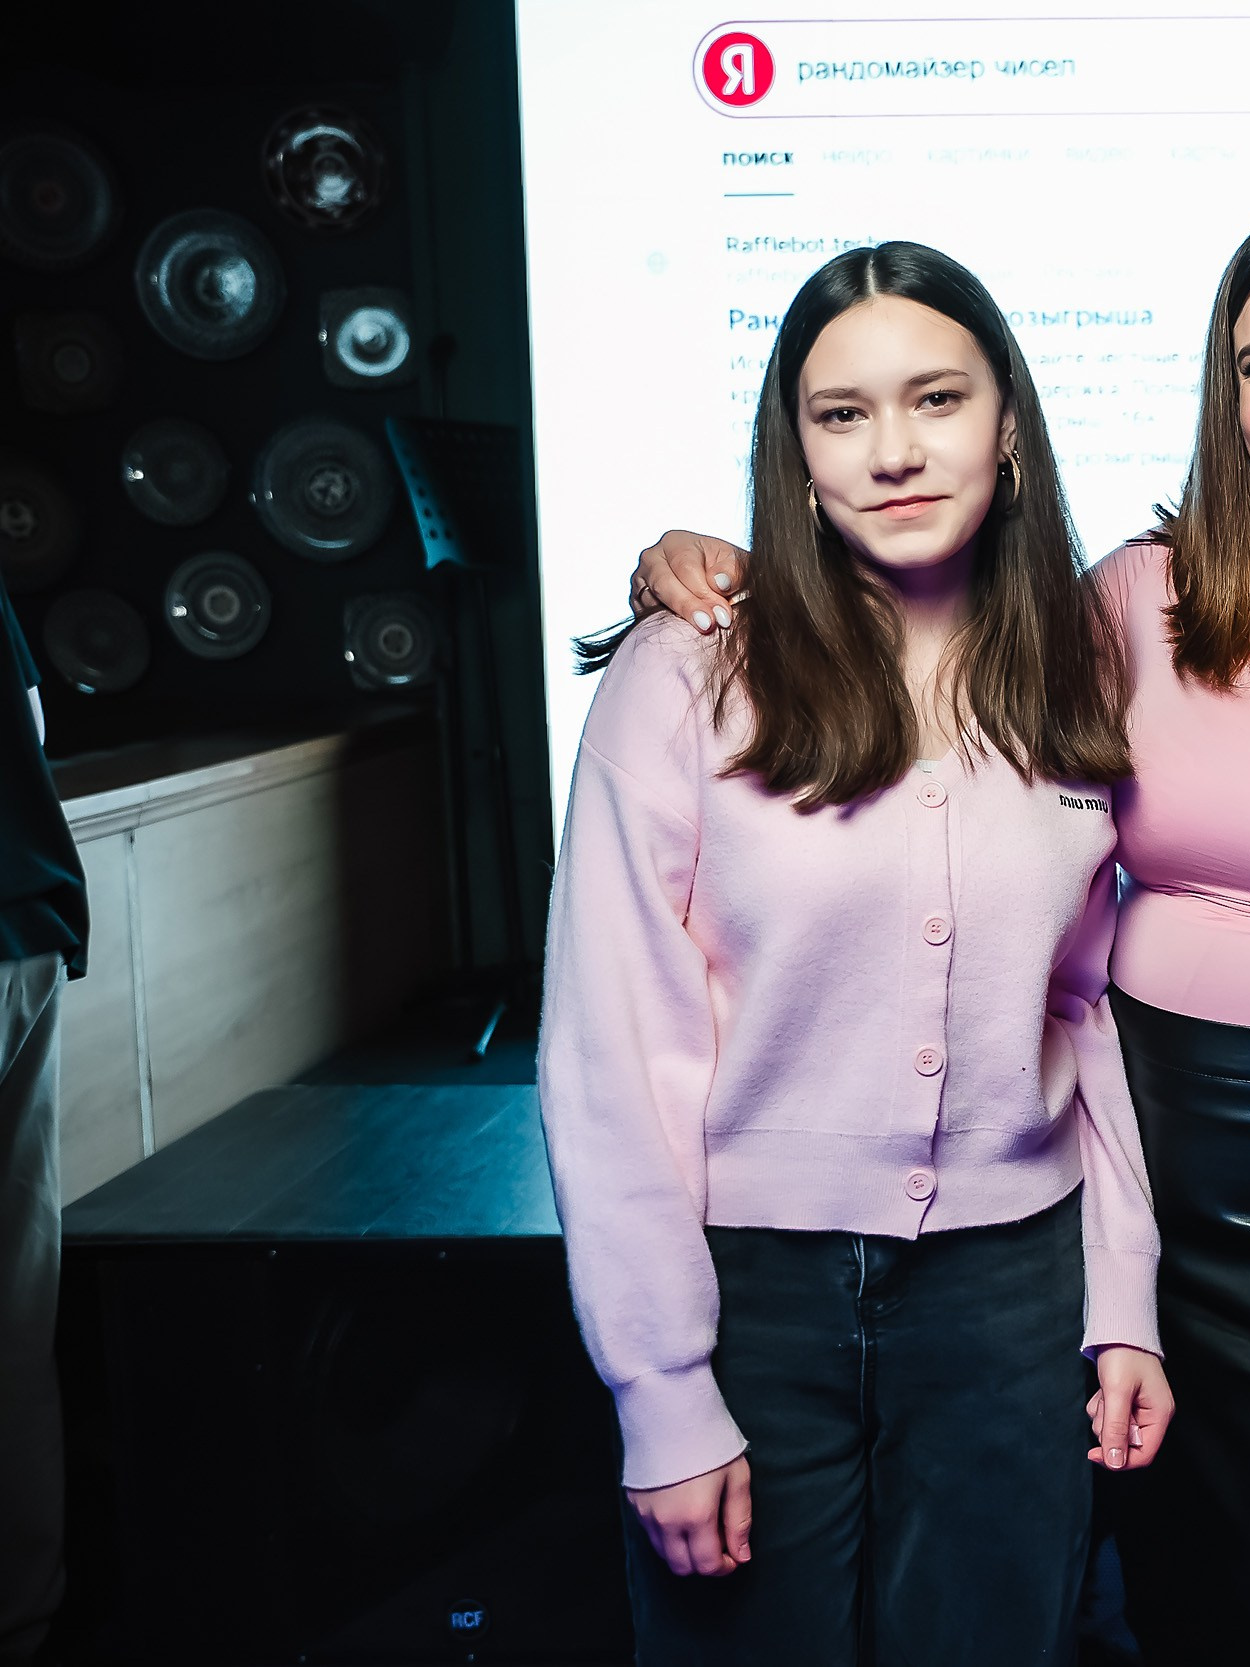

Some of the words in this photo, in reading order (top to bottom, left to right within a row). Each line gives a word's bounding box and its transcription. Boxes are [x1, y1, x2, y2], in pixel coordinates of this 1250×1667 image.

[720, 42, 756, 97] Я
[798, 57, 985, 83] рандомайзер
[995, 58, 1076, 79] чисел
[722, 150, 795, 167] поиск
[1003, 308, 1154, 331] озыгрыша
[1059, 794, 1084, 810] miu
[1085, 799, 1109, 814] miu
[451, 1611, 484, 1628] RCF
